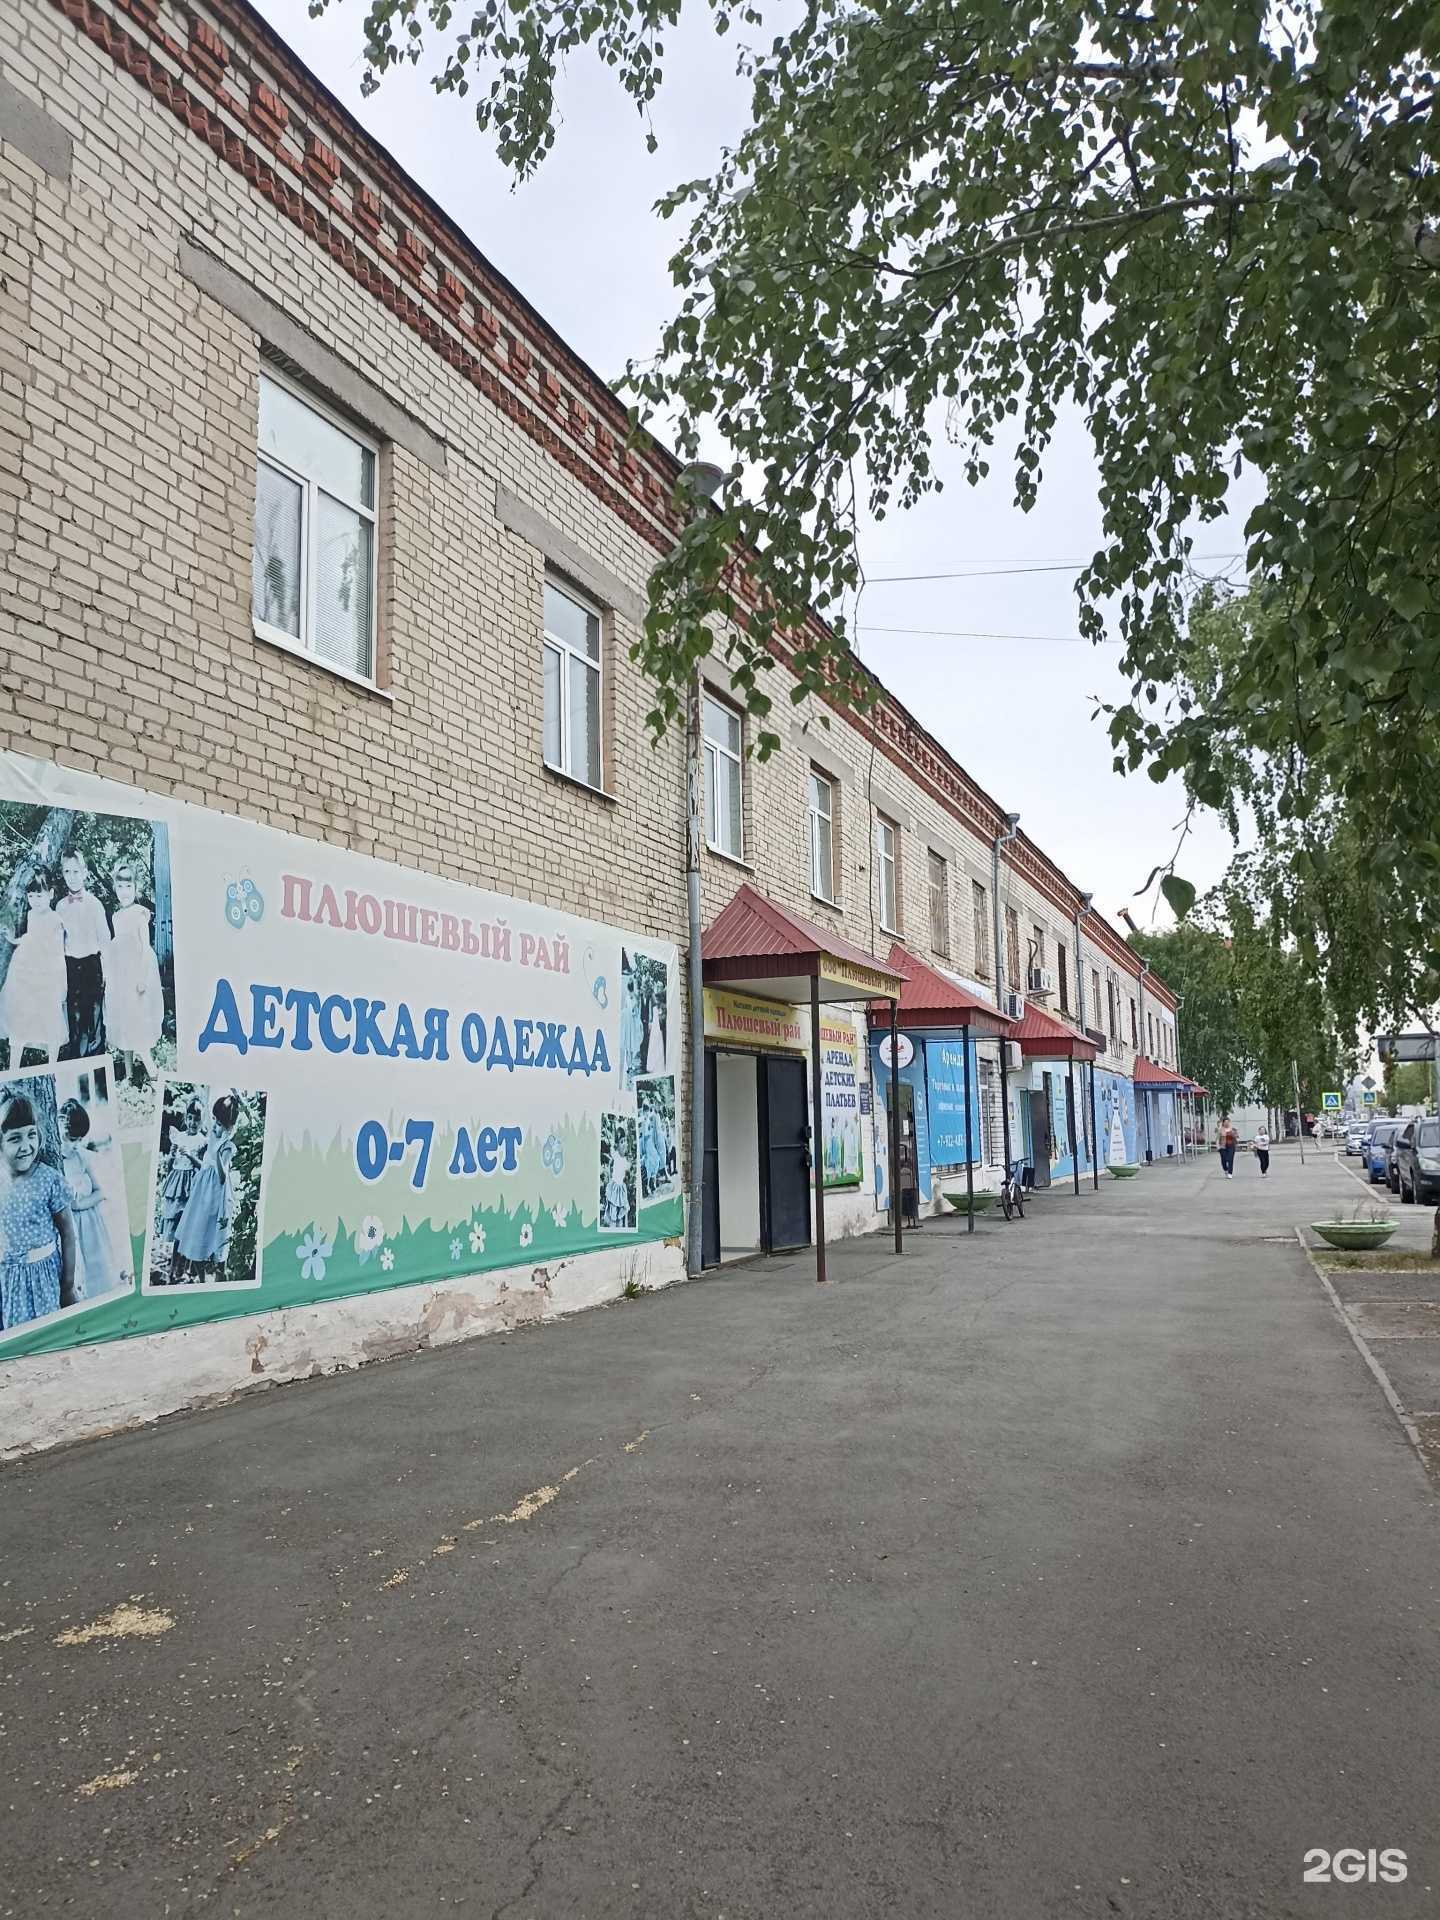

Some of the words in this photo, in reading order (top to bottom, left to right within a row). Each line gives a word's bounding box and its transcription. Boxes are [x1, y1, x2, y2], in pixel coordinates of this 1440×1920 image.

[280, 874, 512, 963] ПЛЮШЕВЫЙ
[519, 932, 571, 974] РАЙ
[198, 977, 450, 1062] ДЕТСКАЯ
[461, 1012, 611, 1077] ОДЕЖДА
[715, 1006, 780, 1036] Плюшевый
[783, 1021, 801, 1041] рай
[826, 1050, 853, 1067] АРЕНДА
[825, 1071, 856, 1087] ДЕТСКИХ
[826, 1092, 856, 1108] ПЛАТЬЕВ
[355, 1117, 435, 1189] 0-7
[448, 1124, 522, 1175] лет
